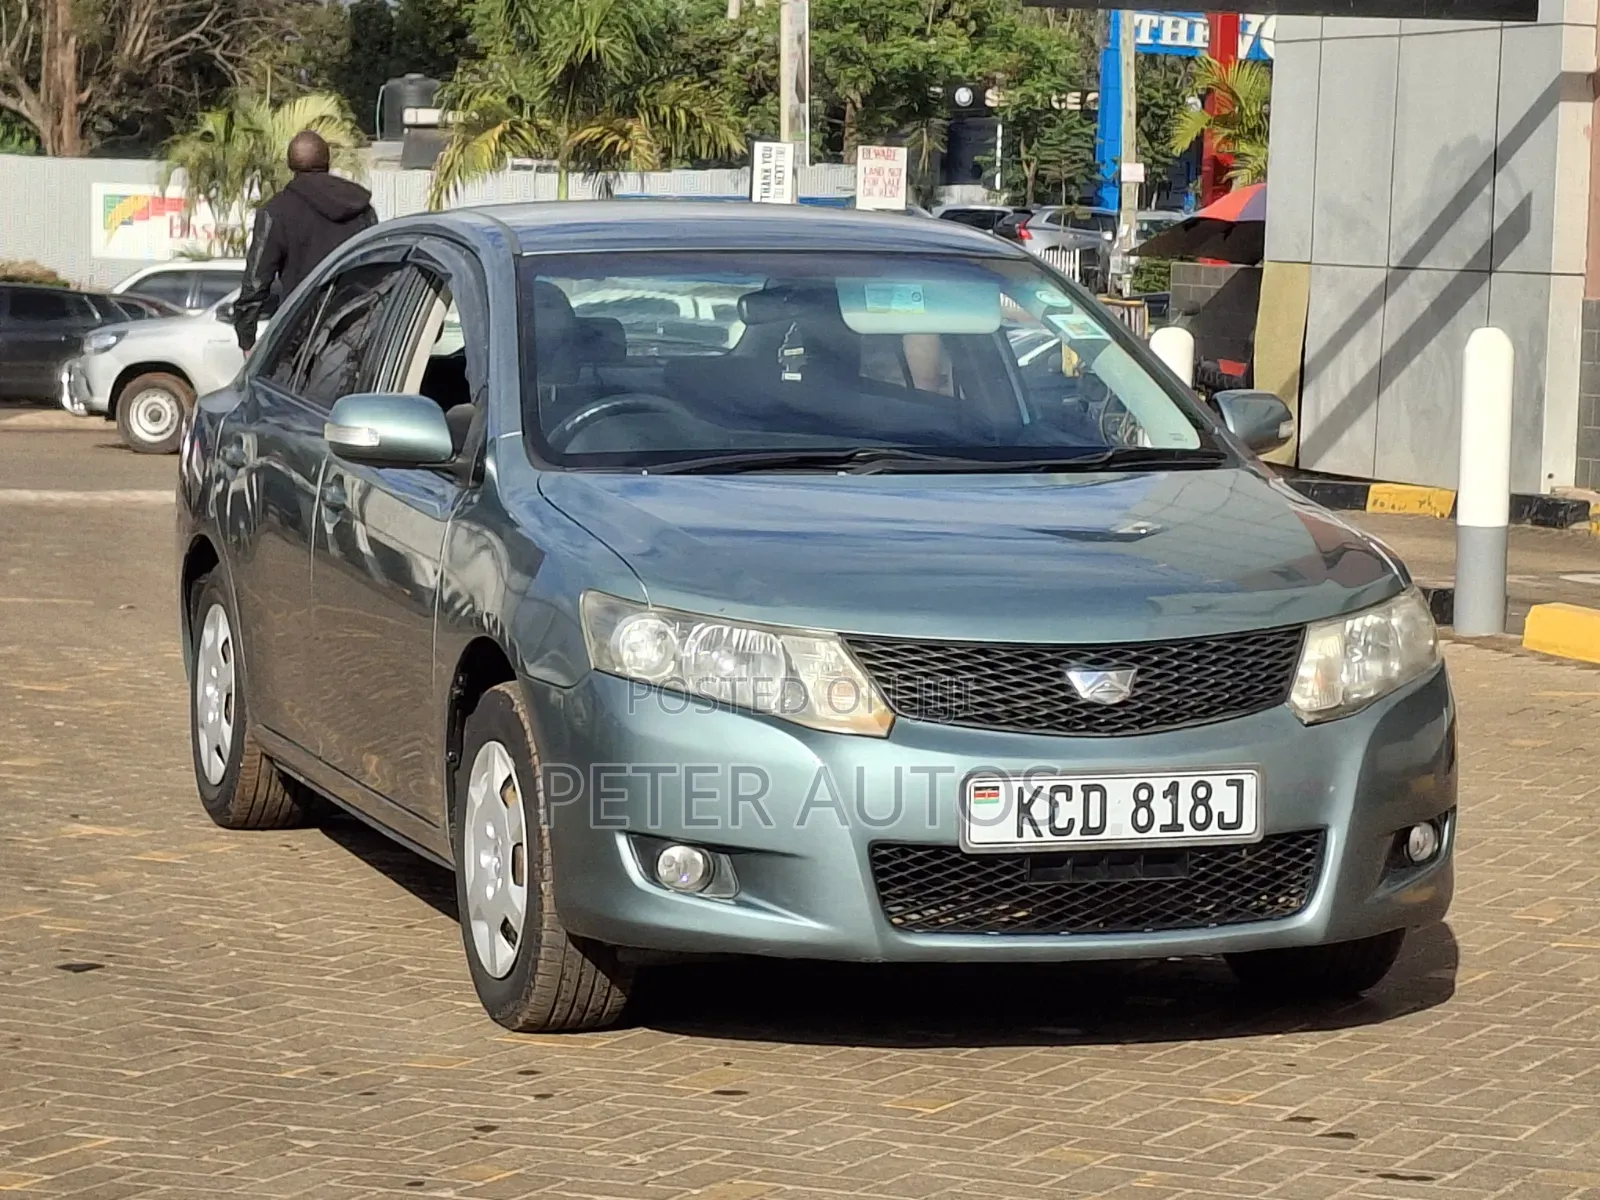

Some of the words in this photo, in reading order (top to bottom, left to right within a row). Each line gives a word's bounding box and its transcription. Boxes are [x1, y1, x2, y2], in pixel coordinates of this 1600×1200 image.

[761, 146, 772, 165] YOU
[862, 148, 898, 161] BEWARE
[1016, 784, 1107, 838] KCD
[1131, 779, 1245, 833] 818J
